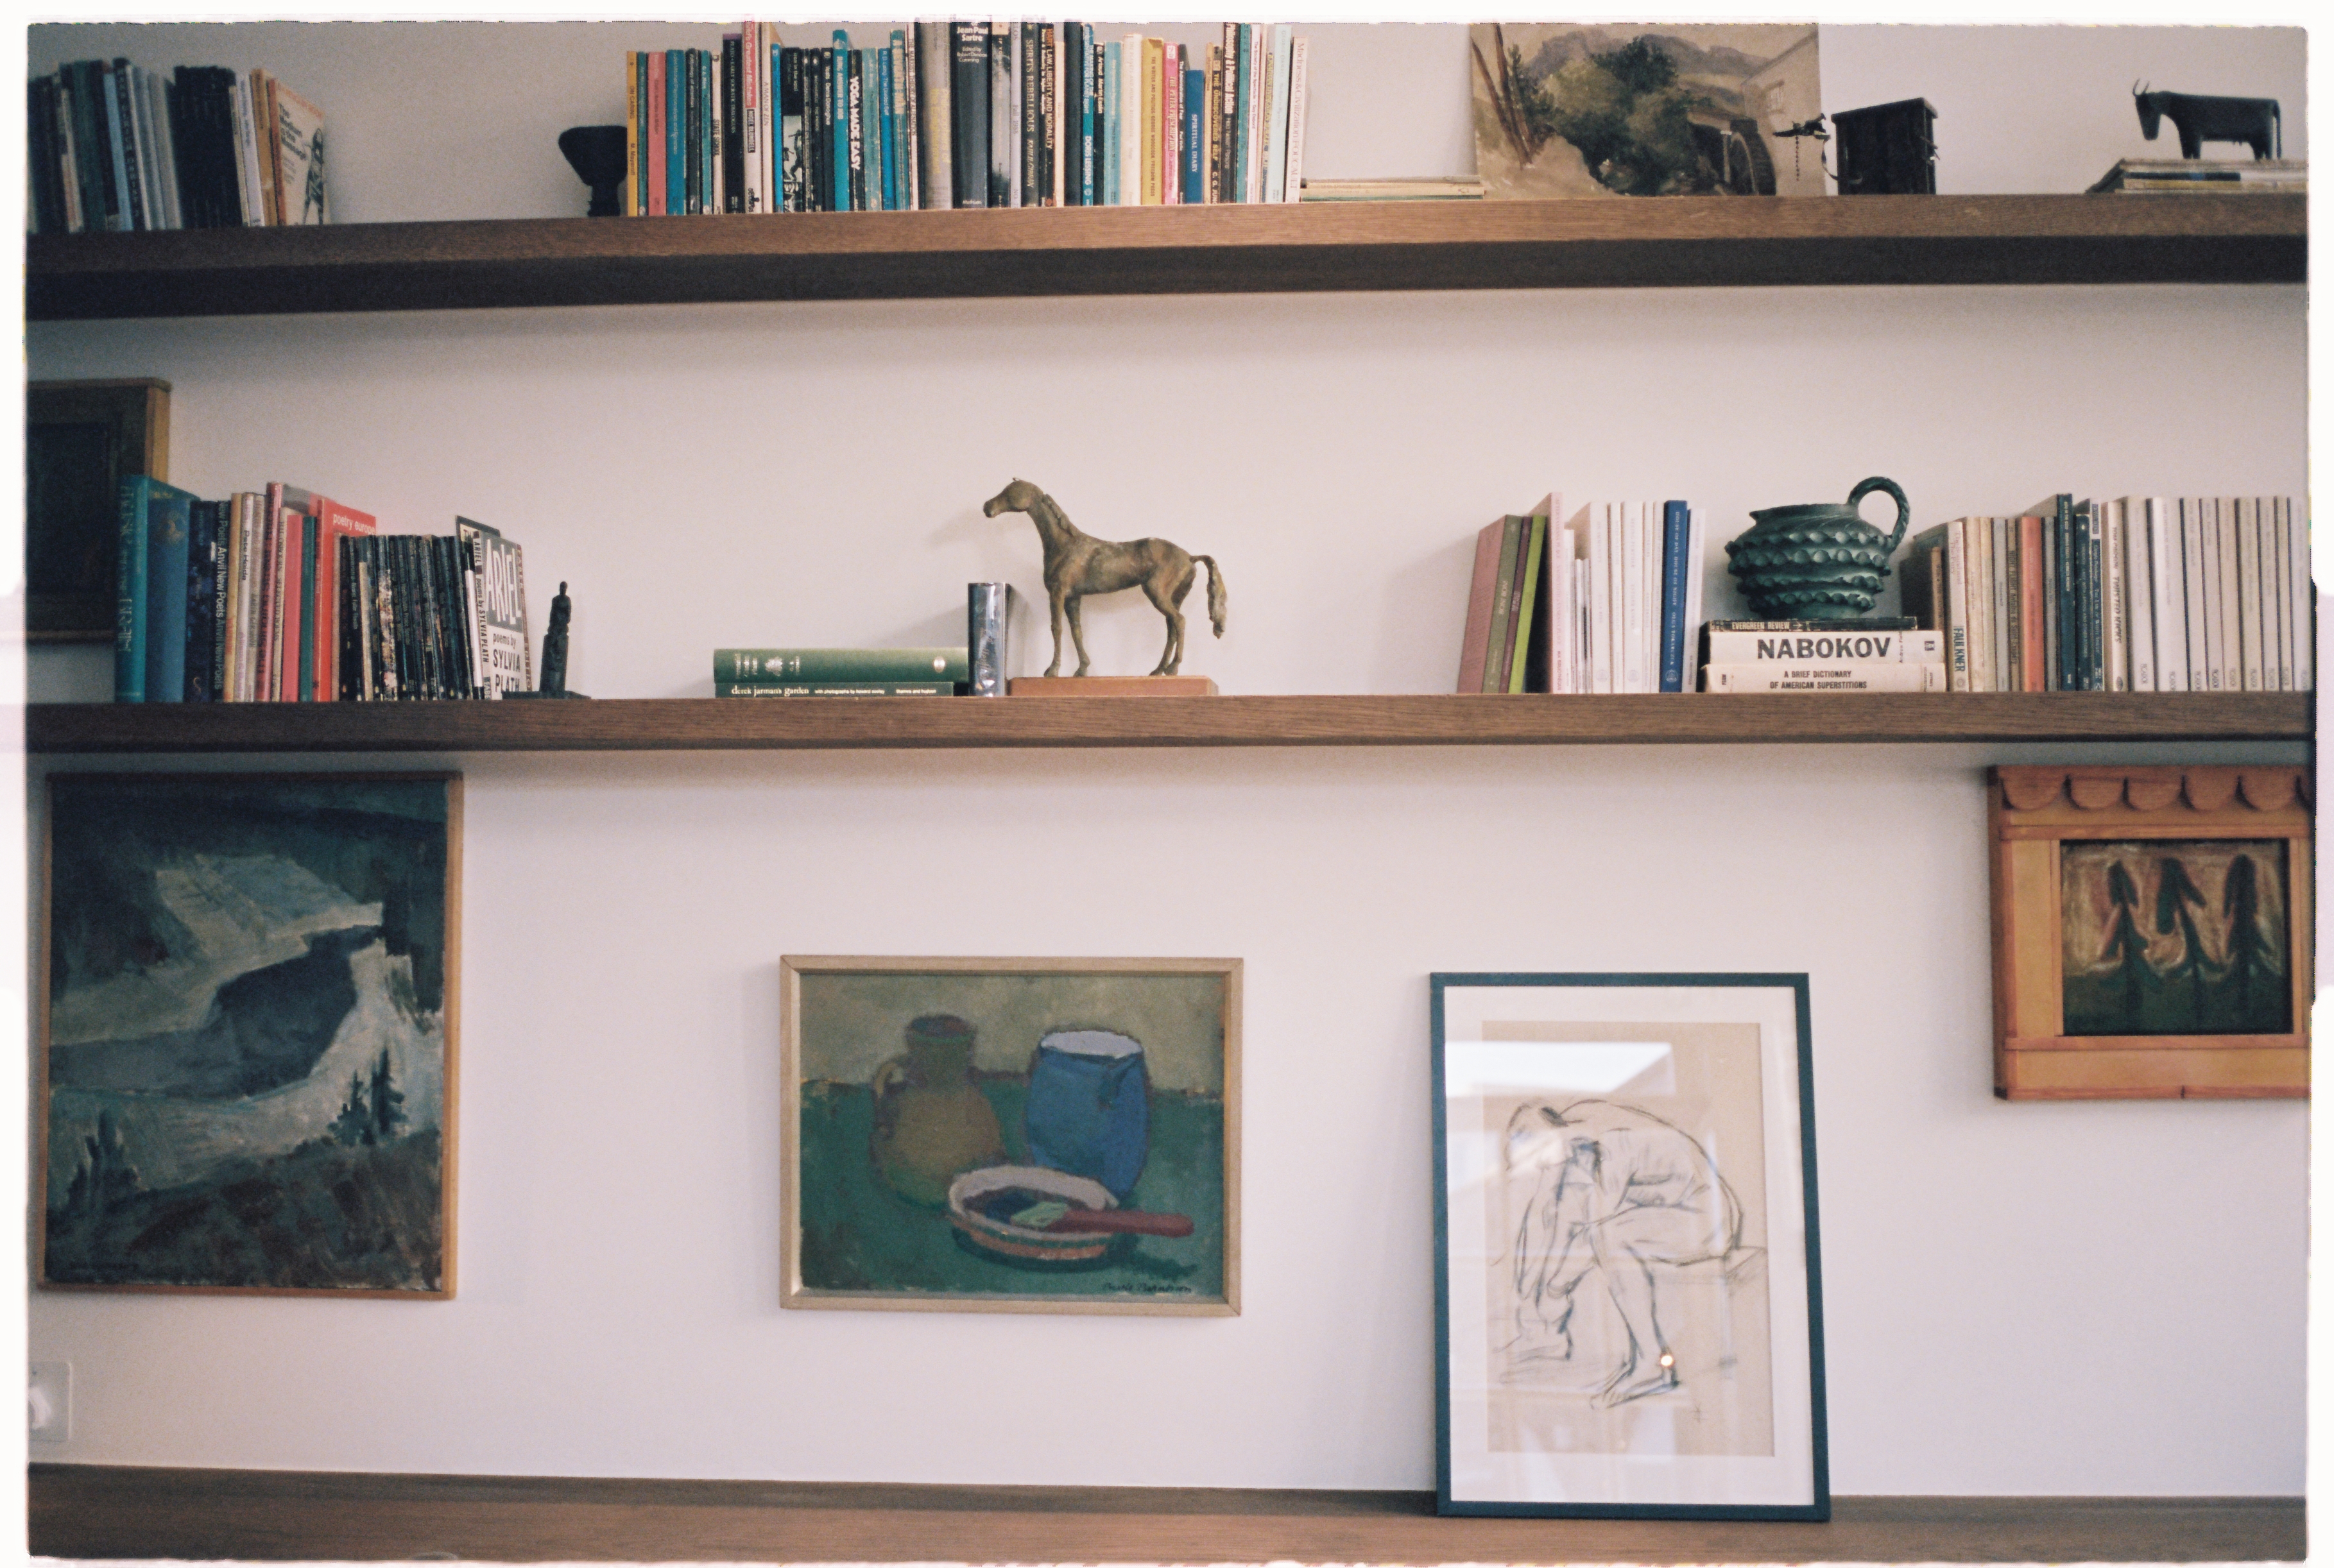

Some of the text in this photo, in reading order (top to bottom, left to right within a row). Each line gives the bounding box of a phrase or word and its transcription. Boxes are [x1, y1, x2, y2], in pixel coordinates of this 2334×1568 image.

[1026, 40, 1034, 72] SPIRITS
[1026, 76, 1034, 132] REBELLIOUS
[850, 76, 861, 170] YOGA MADE EASY
[1167, 109, 1176, 151] PRESCRIPTION
[1289, 141, 1300, 189] FOUCAULT
[218, 520, 227, 546] Poets
[332, 513, 376, 535] poetry europe
[217, 547, 227, 569] Anvil
[474, 541, 482, 565] ARIEL
[217, 570, 227, 591] New
[486, 538, 522, 624] ARIEL
[216, 592, 226, 618] Poets
[477, 600, 485, 609] by
[216, 619, 225, 642] Anvil
[479, 609, 488, 638] SYLVIA
[1731, 621, 1790, 631] EVERGREEN REVIEW
[215, 643, 225, 663] New
[481, 638, 490, 663] PLATH
[492, 633, 517, 650] poems by
[1756, 636, 1891, 660] NABOKOV
[1953, 627, 1966, 672] FAULKNER
[492, 648, 520, 673] SYLVIA
[495, 673, 520, 692] PLATH
[1769, 681, 1867, 690] OF AMERICAN SUPERSTITIONS
[1790, 670, 1810, 679] BRIEF
[1812, 670, 1852, 679] DICTIONARY
[2140, 663, 2149, 685] PICADOR
[2211, 669, 2220, 688] PICADOR
[2249, 669, 2258, 688] PICADOR
[730, 684, 751, 695] derek
[753, 685, 782, 697] jarman's
[784, 686, 810, 697] garden
